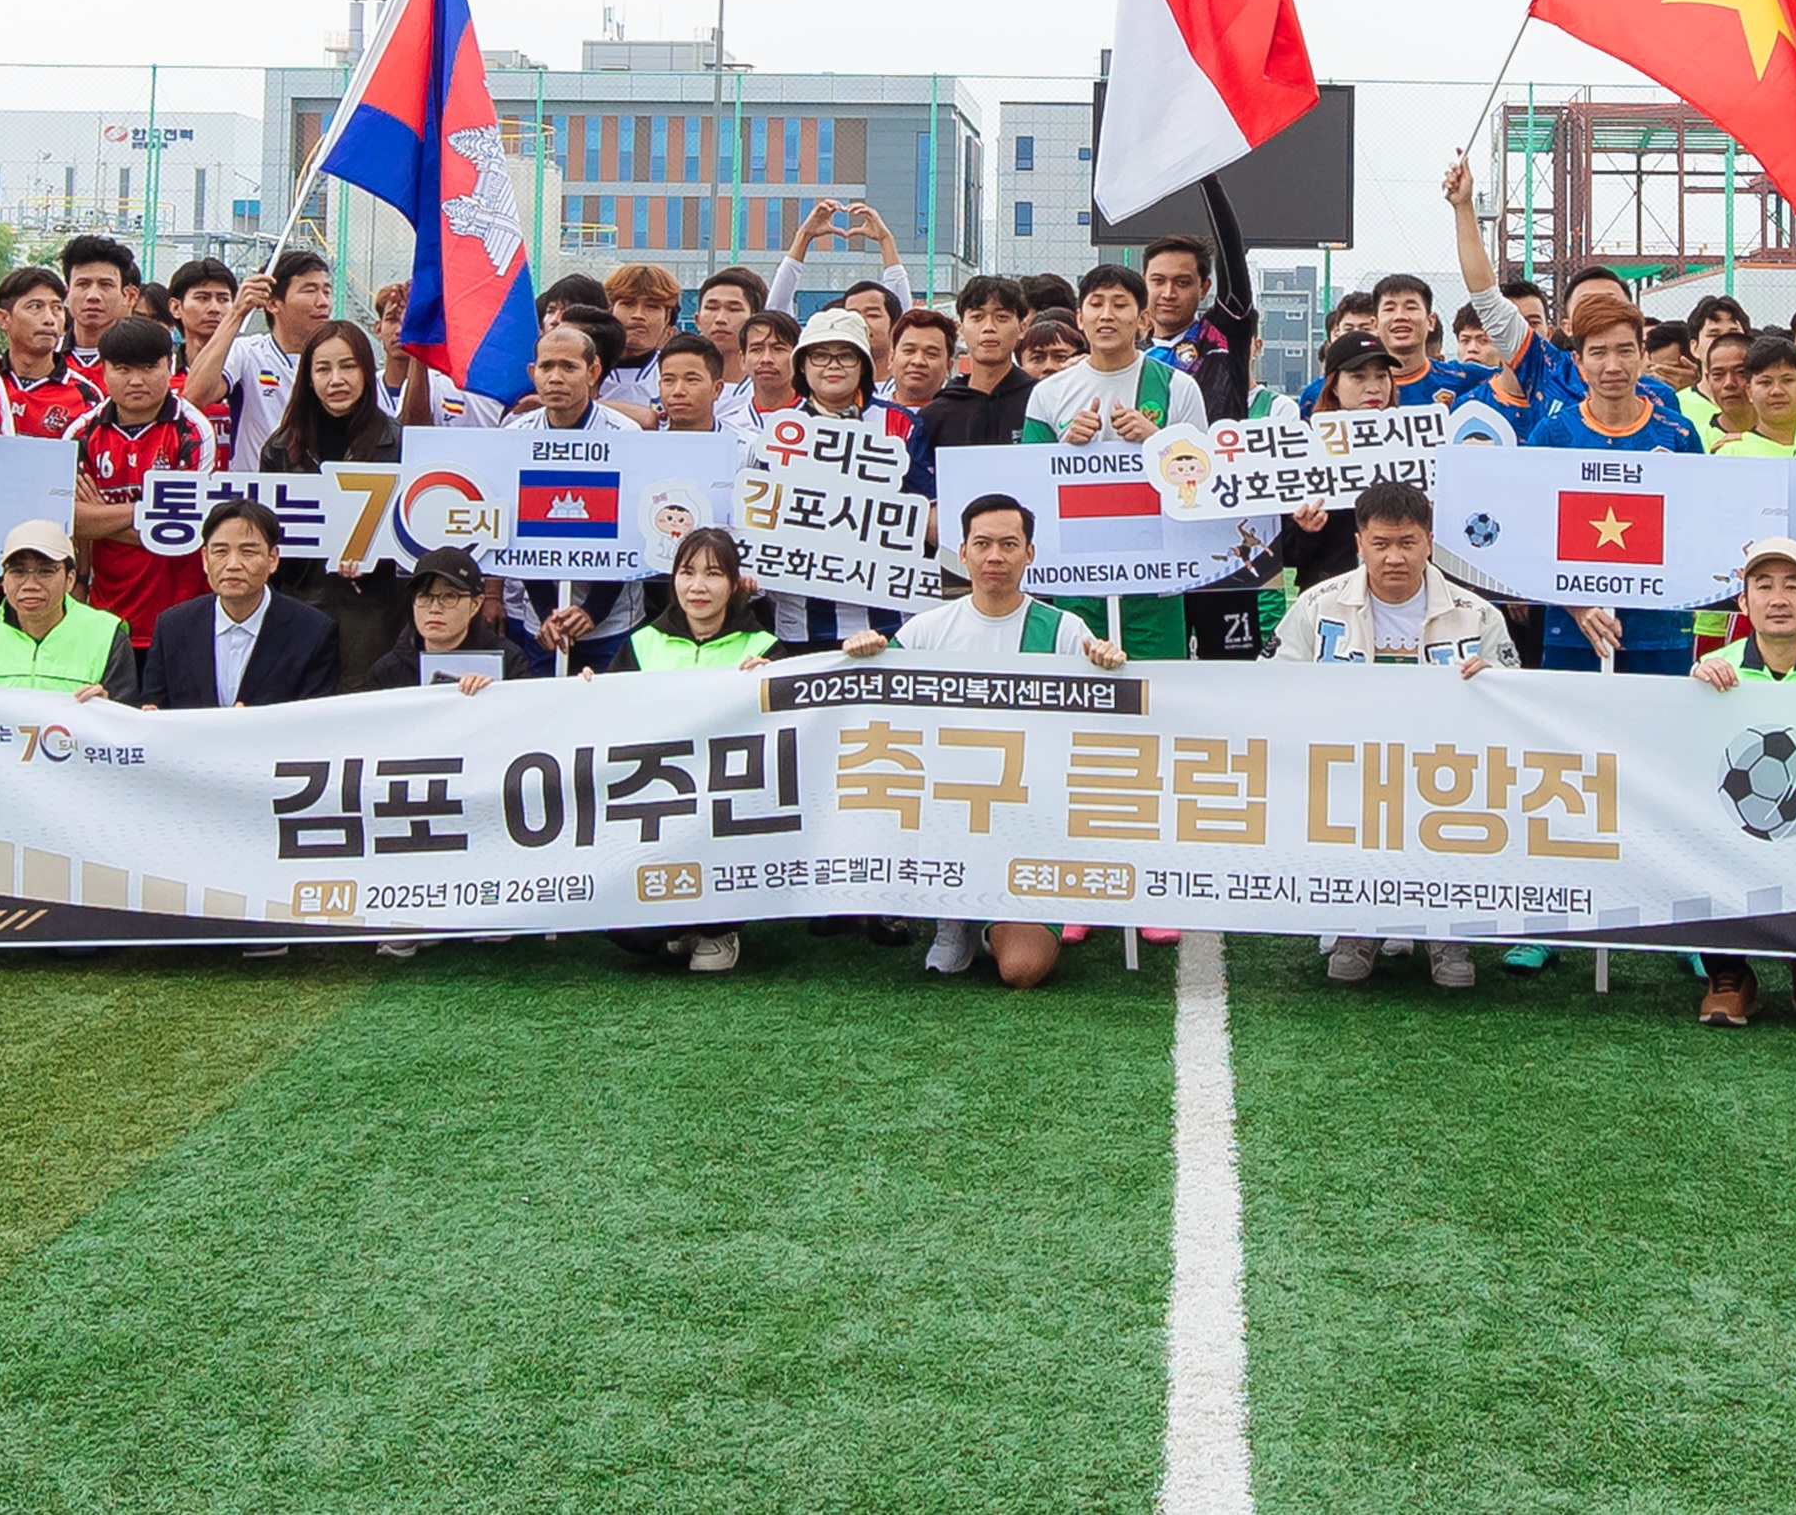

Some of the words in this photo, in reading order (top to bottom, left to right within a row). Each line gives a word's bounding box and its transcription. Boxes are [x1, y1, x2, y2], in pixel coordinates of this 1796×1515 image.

[532, 441, 611, 463] 캄보디아
[766, 422, 899, 483] 우리는
[1214, 426, 1309, 463] 우리는
[1319, 413, 1446, 456] 김포시민
[1051, 454, 1144, 475] INDONES
[1211, 459, 1436, 508] 상호문화도시김
[1581, 462, 1644, 484] 베트남
[444, 509, 500, 539] 도시
[742, 479, 919, 551] 김포시민
[495, 548, 564, 568] KHMER
[567, 550, 611, 569] KRM
[615, 550, 639, 569] FC
[737, 539, 878, 591] 호문화도시
[887, 565, 943, 600] 김포
[1027, 564, 1128, 585] INDONESIA
[1134, 563, 1172, 580] ONE
[1177, 561, 1200, 578] FC
[1556, 574, 1635, 595] DAEGOT
[1640, 576, 1665, 596] FC
[793, 674, 884, 705] 2025년
[889, 675, 1116, 709] 외국인복지센터사업
[18, 724, 72, 762] 70
[59, 739, 79, 752] 도시
[84, 747, 112, 764] 우리
[116, 747, 146, 765] 김포
[271, 757, 469, 860] 김포
[503, 727, 804, 848] 이주민
[836, 720, 1029, 835] 축구
[1065, 731, 1269, 846] 클럽
[1306, 741, 1621, 861] 대항전
[297, 885, 351, 914] 일시
[365, 883, 447, 911] 2025년
[453, 880, 500, 907] 10월
[506, 875, 595, 905] 26일(일)
[643, 868, 697, 896] 장소
[712, 864, 757, 892] 김포
[763, 860, 809, 889] 양촌
[814, 857, 892, 885] 골드벨리
[897, 859, 965, 889] 축구장
[1146, 869, 1219, 901] 경기도,
[1226, 872, 1301, 905] 김포시,
[1309, 875, 1592, 916] 김포시외국인주민지원센터
